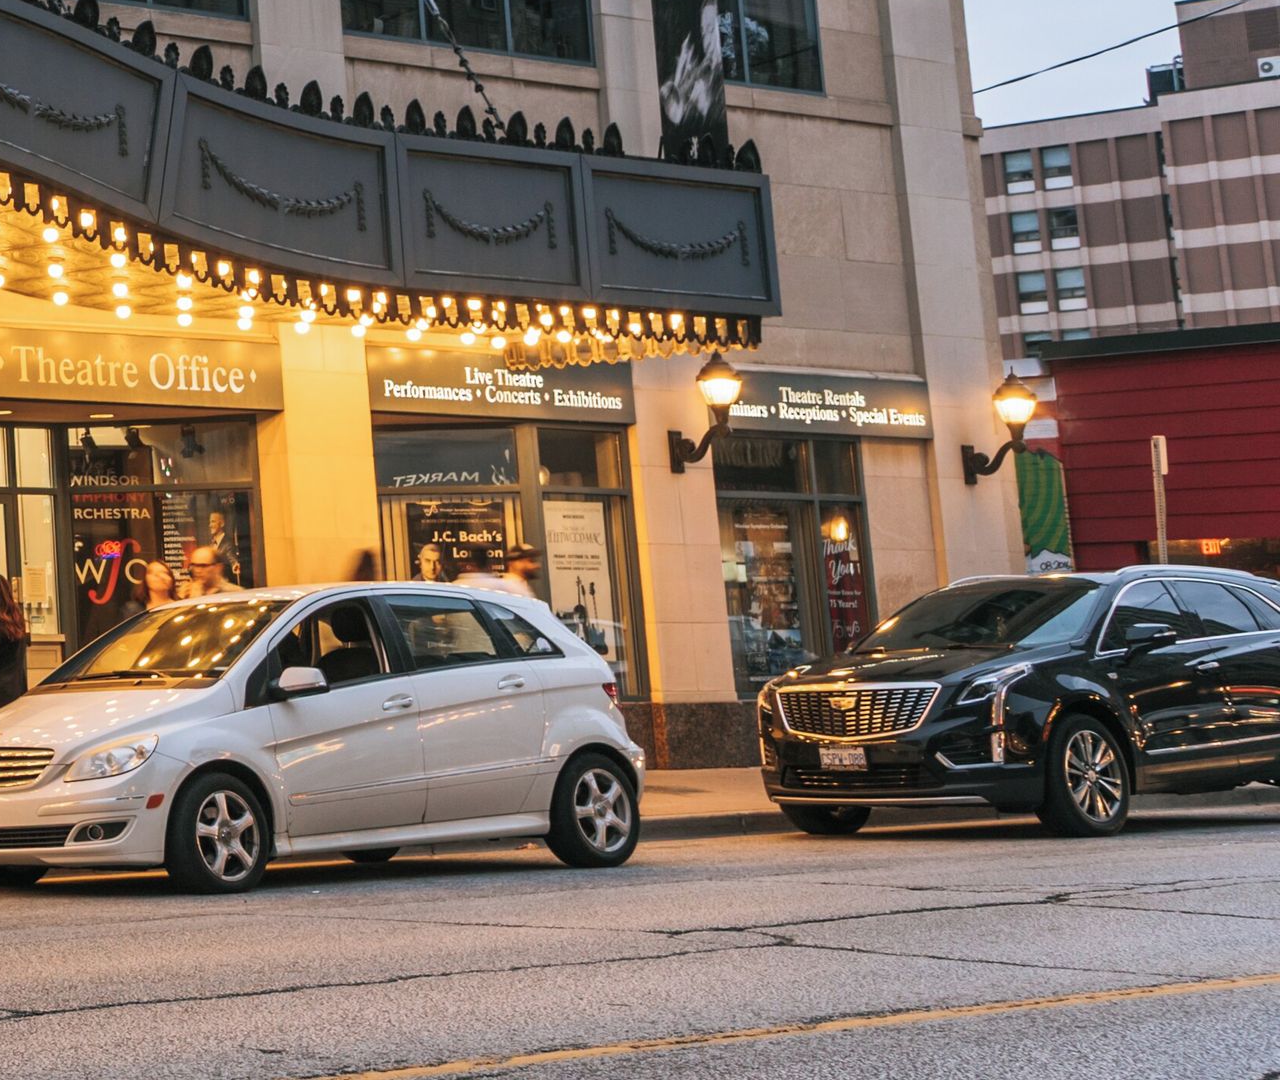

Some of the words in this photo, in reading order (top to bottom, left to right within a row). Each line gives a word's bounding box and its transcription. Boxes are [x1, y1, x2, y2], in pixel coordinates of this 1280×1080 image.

[11, 345, 139, 388] Theatre
[149, 353, 246, 394] Office
[465, 367, 493, 386] Live
[494, 368, 544, 389] Theatre
[383, 379, 473, 402] Performances
[485, 385, 542, 405] Concerts
[553, 389, 623, 410] Exhibitions
[779, 386, 823, 405] Theatre
[824, 389, 866, 407] Rentals
[729, 401, 768, 418] minars
[778, 402, 840, 424] Receptions
[850, 407, 888, 426] Special
[890, 408, 926, 426] Events
[70, 475, 140, 487] WINDSOR
[73, 507, 151, 520] RCHESTRA
[431, 530, 456, 542] J.C.
[459, 529, 503, 543] Bach's
[822, 532, 857, 557] Thank
[452, 547, 504, 558] Loon
[1202, 540, 1221, 555] EXIT
